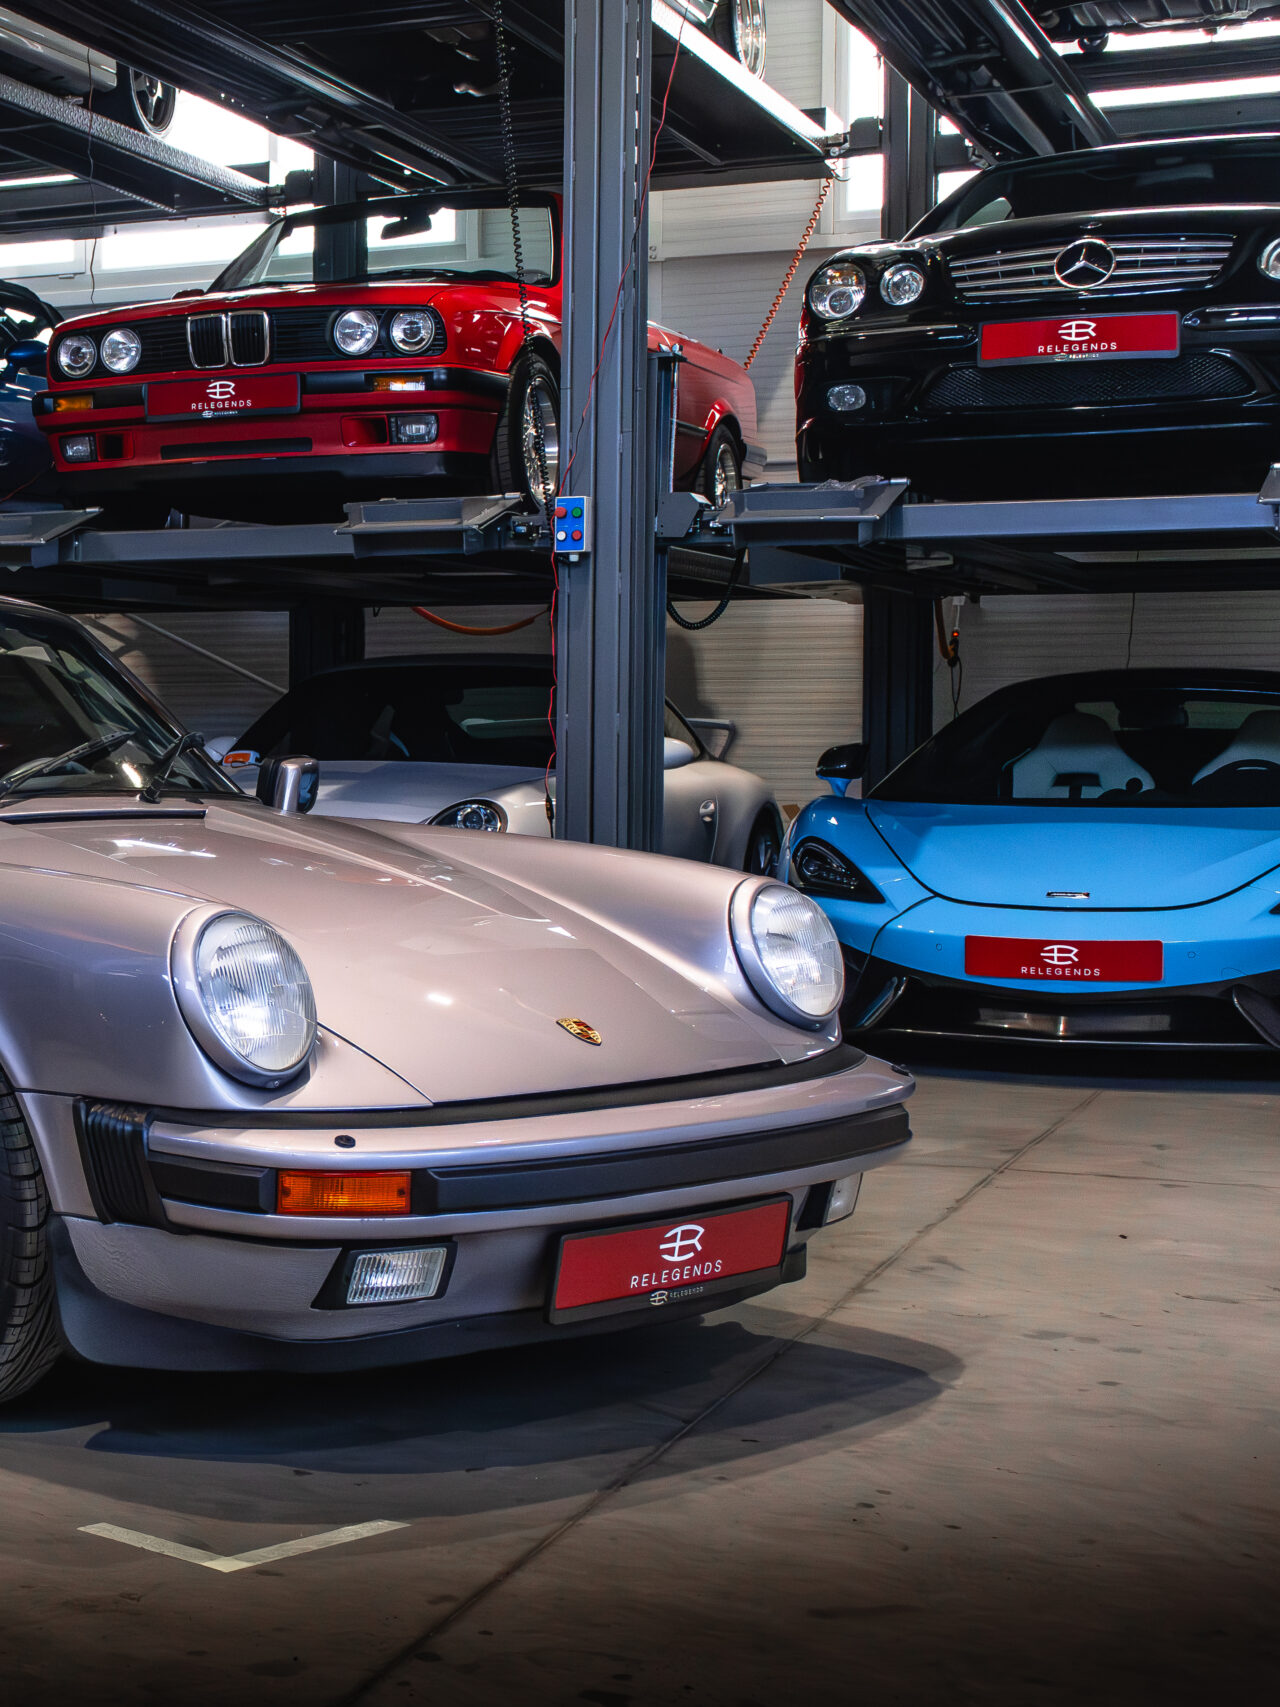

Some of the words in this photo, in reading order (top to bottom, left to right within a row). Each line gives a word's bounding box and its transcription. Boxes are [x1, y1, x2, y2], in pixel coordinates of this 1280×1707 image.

[1038, 342, 1118, 353] RELEGENDS
[191, 400, 252, 410] RELEGENDS
[1021, 966, 1101, 976] RELEGENDS
[630, 1259, 723, 1289] RELEGENDS
